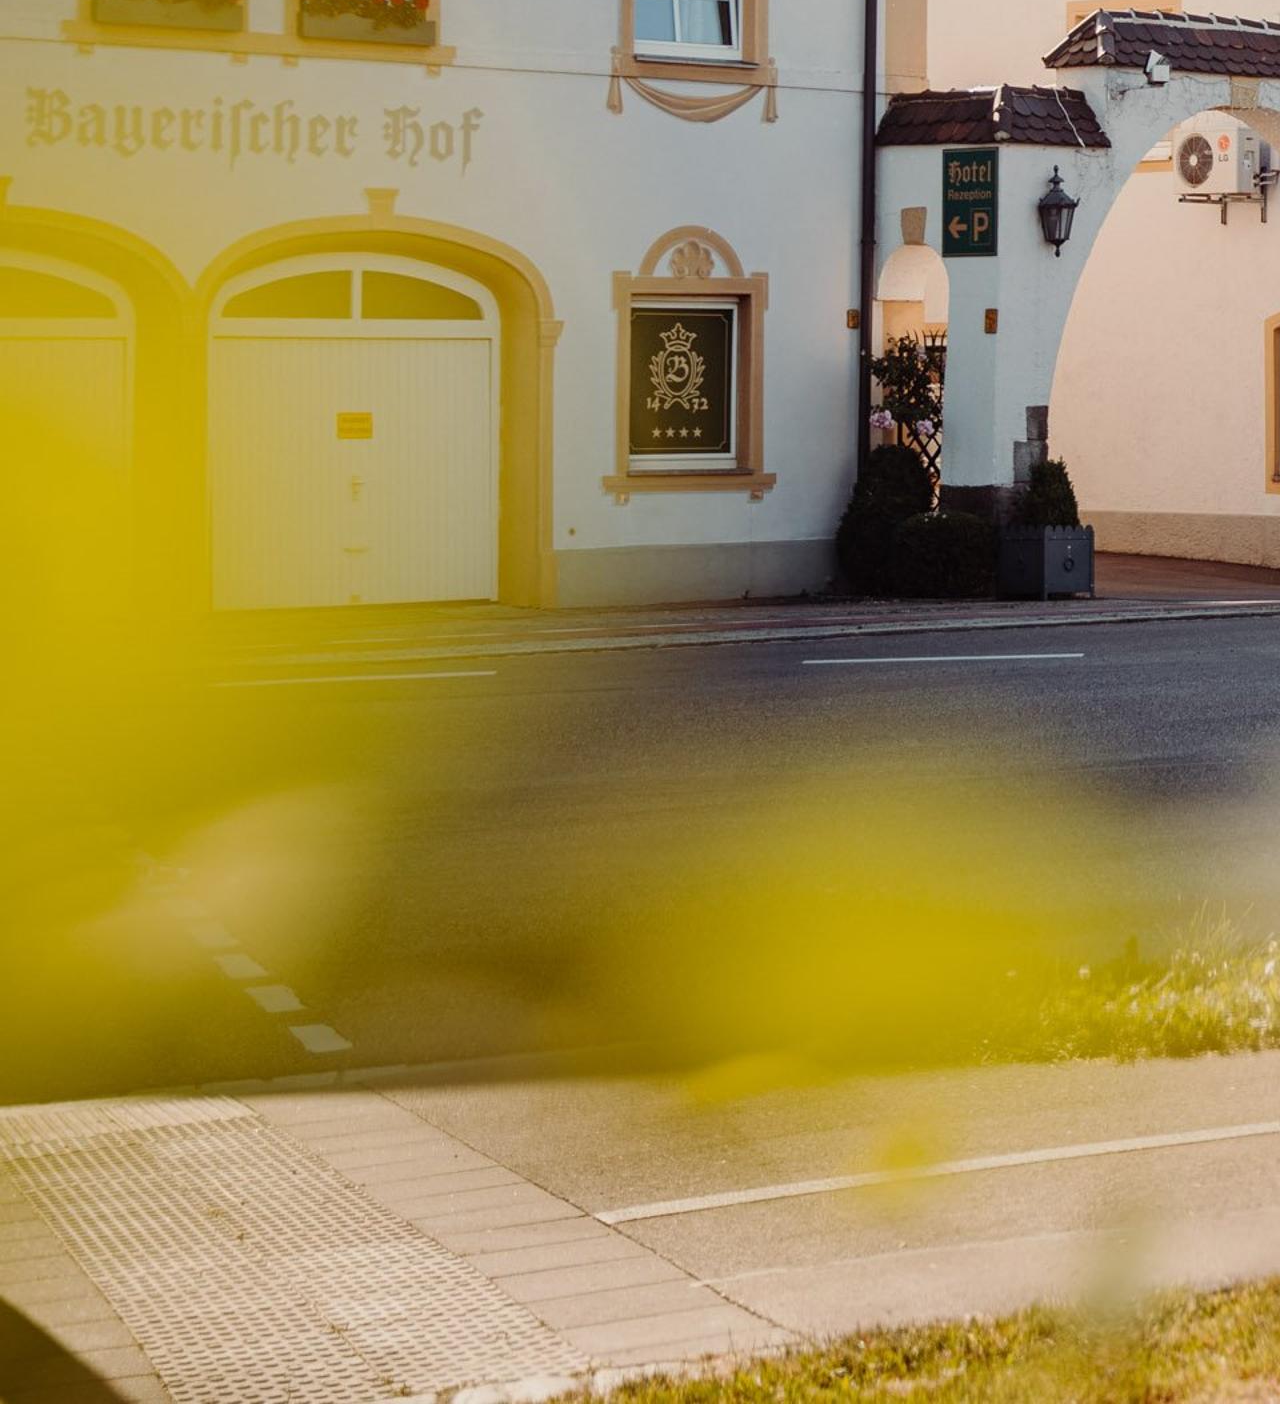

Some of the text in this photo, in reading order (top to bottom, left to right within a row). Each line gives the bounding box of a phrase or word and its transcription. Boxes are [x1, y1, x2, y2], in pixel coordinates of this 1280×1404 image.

[383, 104, 486, 177] Hof
[948, 161, 992, 186] Hotel
[947, 189, 992, 201] Rezeption
[667, 355, 689, 383] B
[646, 397, 709, 413] 14 72
